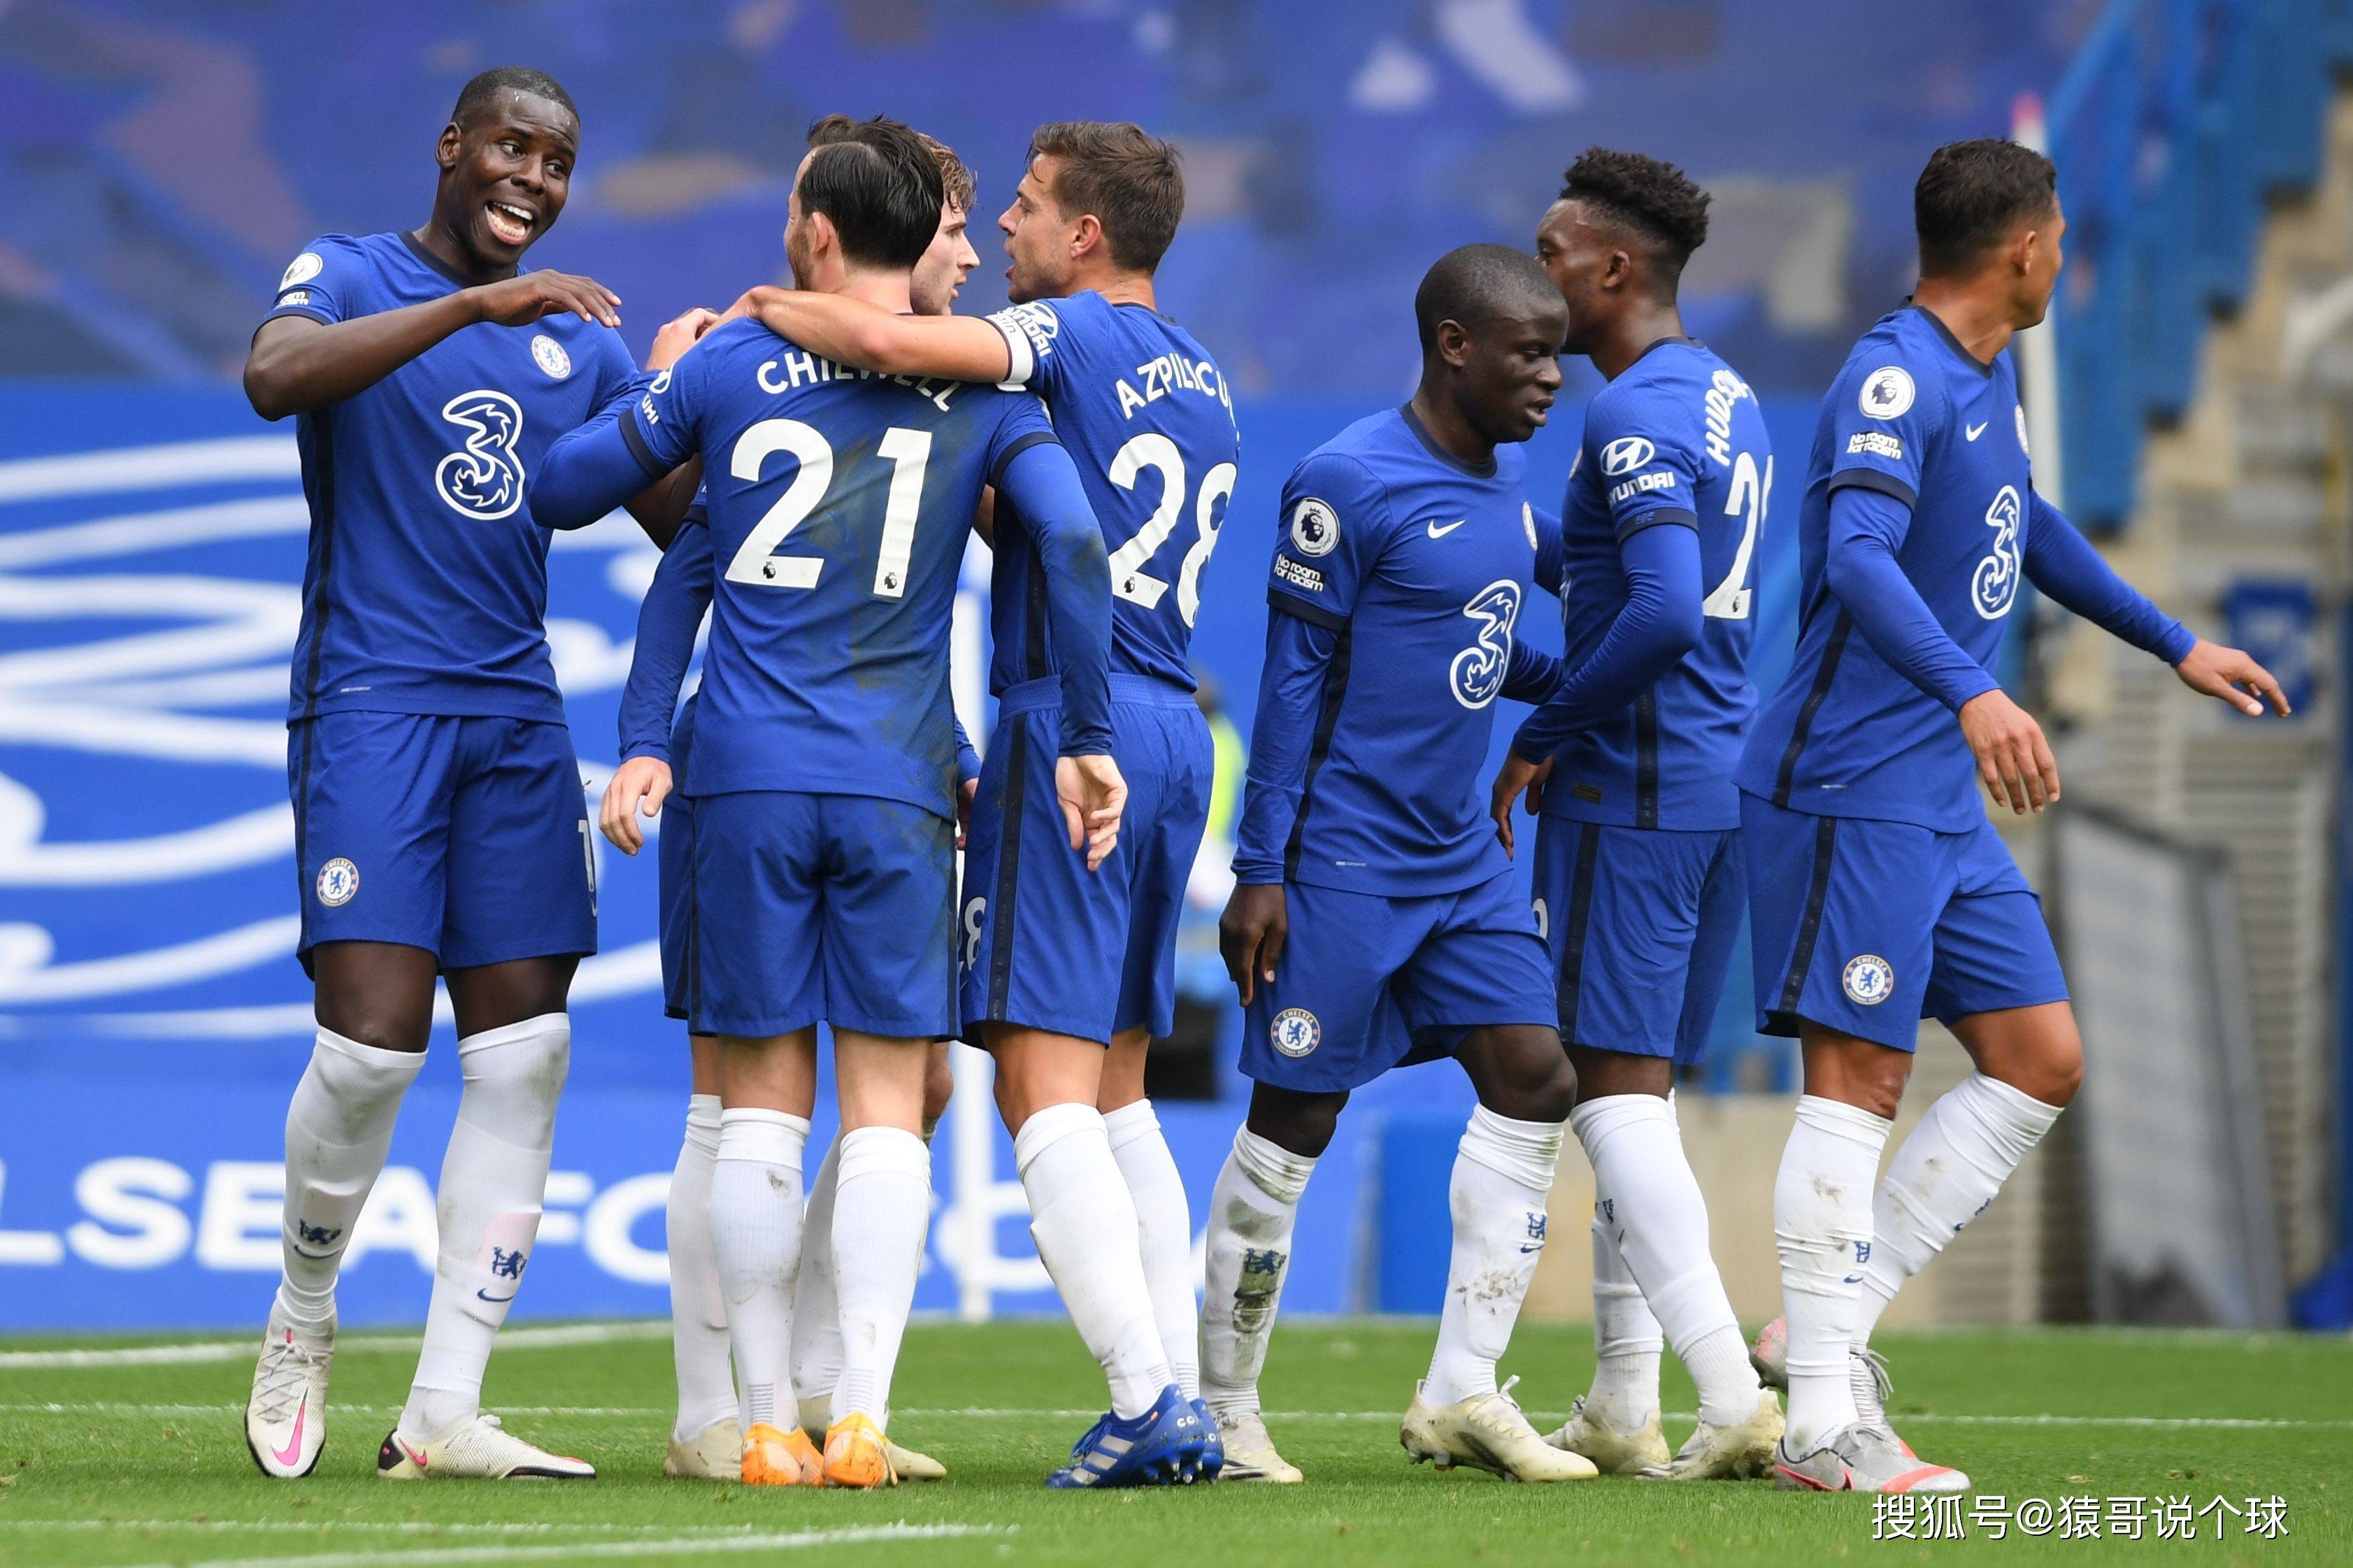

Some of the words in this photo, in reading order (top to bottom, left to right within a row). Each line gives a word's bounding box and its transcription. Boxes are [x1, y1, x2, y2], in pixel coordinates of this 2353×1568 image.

[1865, 432, 1898, 449] room
[724, 419, 933, 599] 21
[1108, 432, 1238, 629] 28
[1703, 451, 1773, 620] 2
[1275, 553, 1290, 569] No
[1289, 562, 1321, 582] room
[1286, 572, 1324, 592] racism
[1282, 1010, 1314, 1025] CHELSEA
